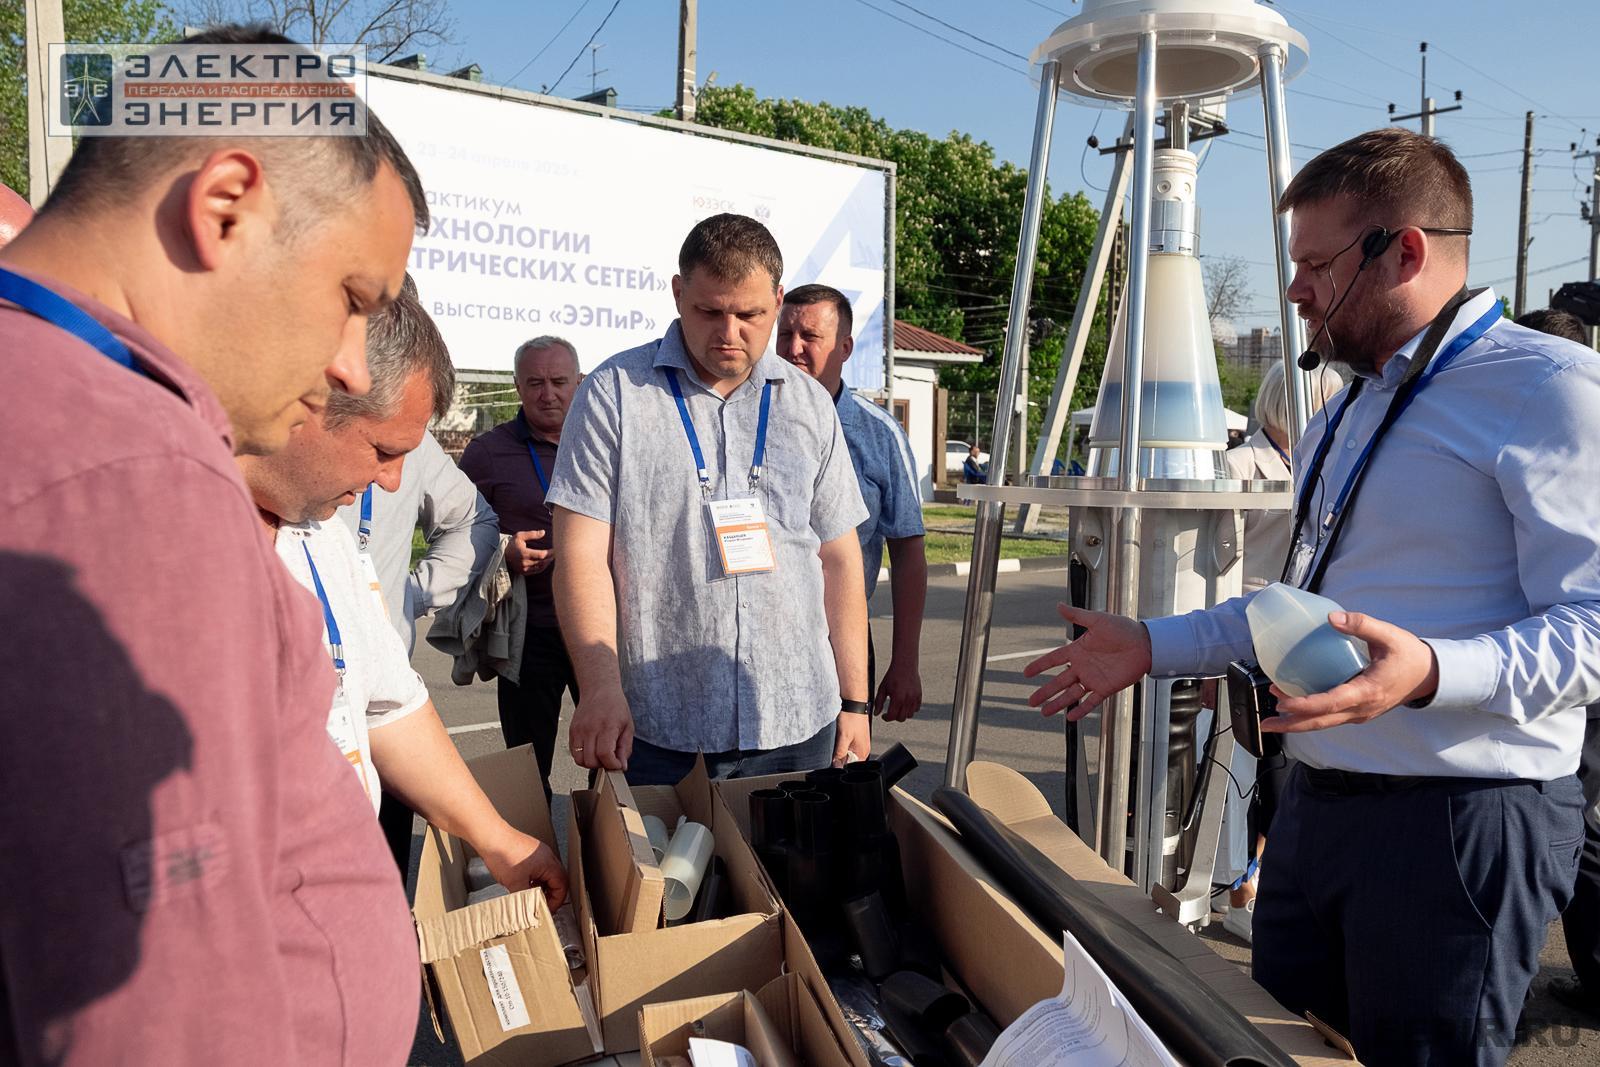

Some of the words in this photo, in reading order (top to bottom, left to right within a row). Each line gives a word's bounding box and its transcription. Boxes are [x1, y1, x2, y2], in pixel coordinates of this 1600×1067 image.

[424, 190, 522, 219] актикум
[416, 215, 591, 255] ХНОЛОГИИ
[408, 246, 577, 284] ТРИЧЕСКИХ
[583, 264, 667, 292] СЕТЕЙ»
[432, 301, 541, 323] выставка
[549, 303, 656, 331] «ЭЭПиР»
